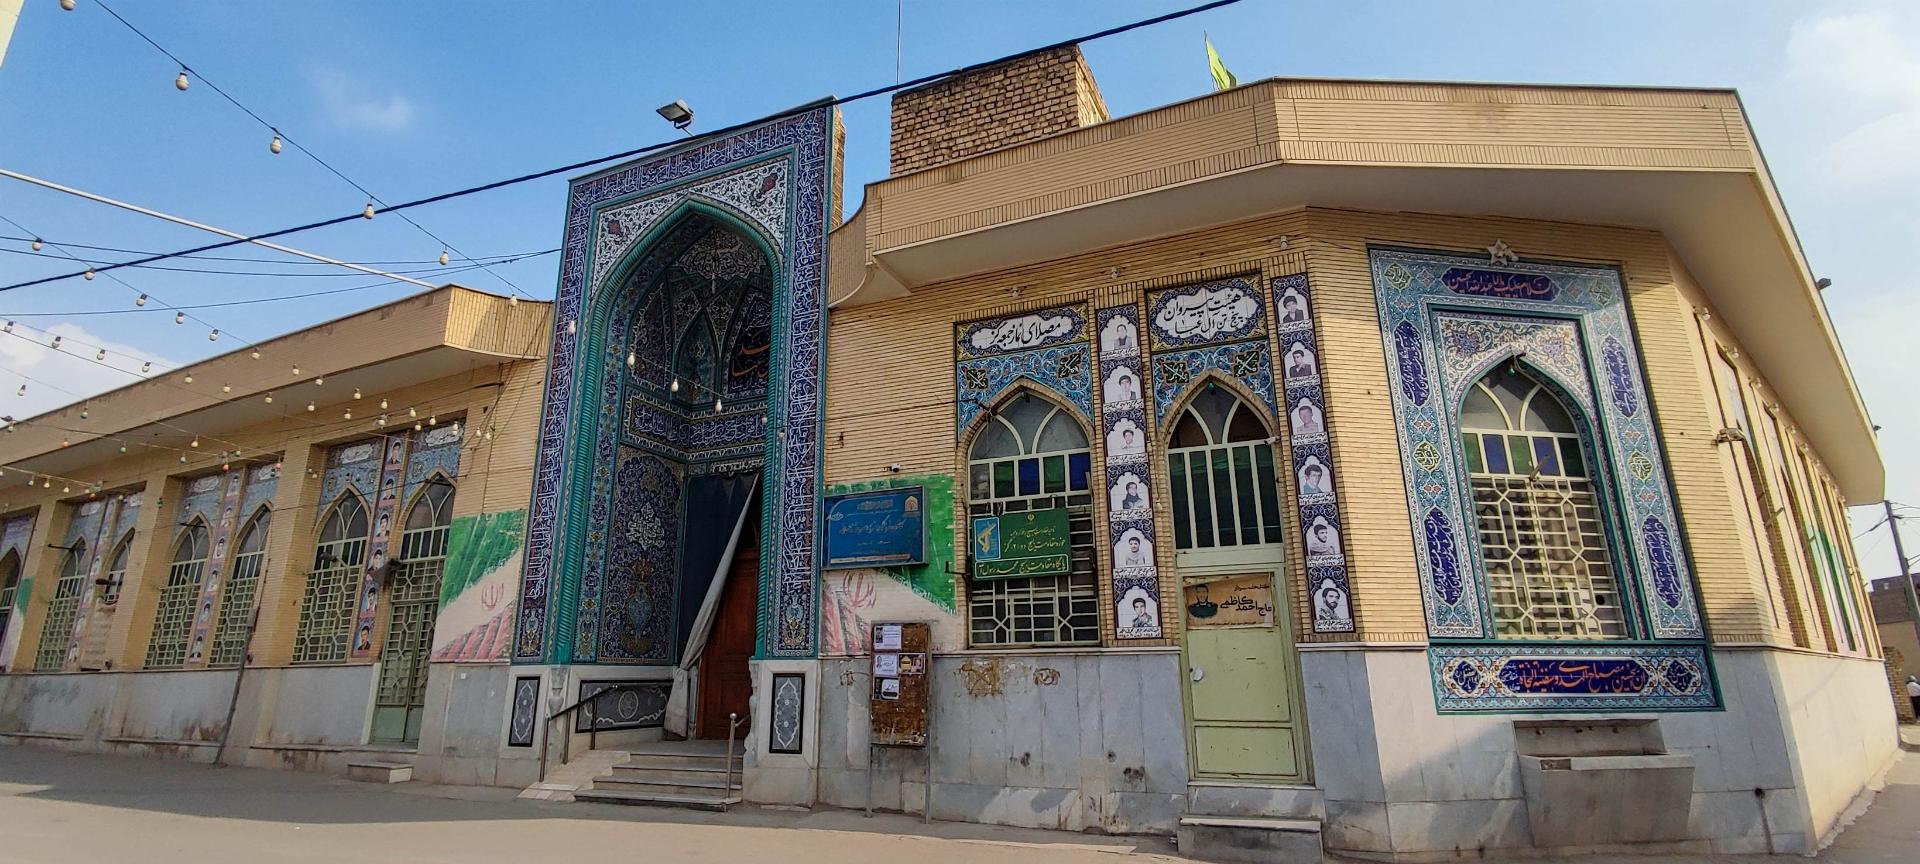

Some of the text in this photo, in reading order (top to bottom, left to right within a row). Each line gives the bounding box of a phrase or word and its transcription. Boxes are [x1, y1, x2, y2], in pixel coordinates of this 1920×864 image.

[1164, 295, 1215, 321] پیروان
[1217, 313, 1227, 329] تن
[1022, 322, 1061, 344] مصلای
[1028, 558, 1051, 570] مقاومت
[1220, 596, 1253, 608] کاظمی
[1236, 601, 1258, 611] احمد
[1588, 662, 1625, 692] مصباح
